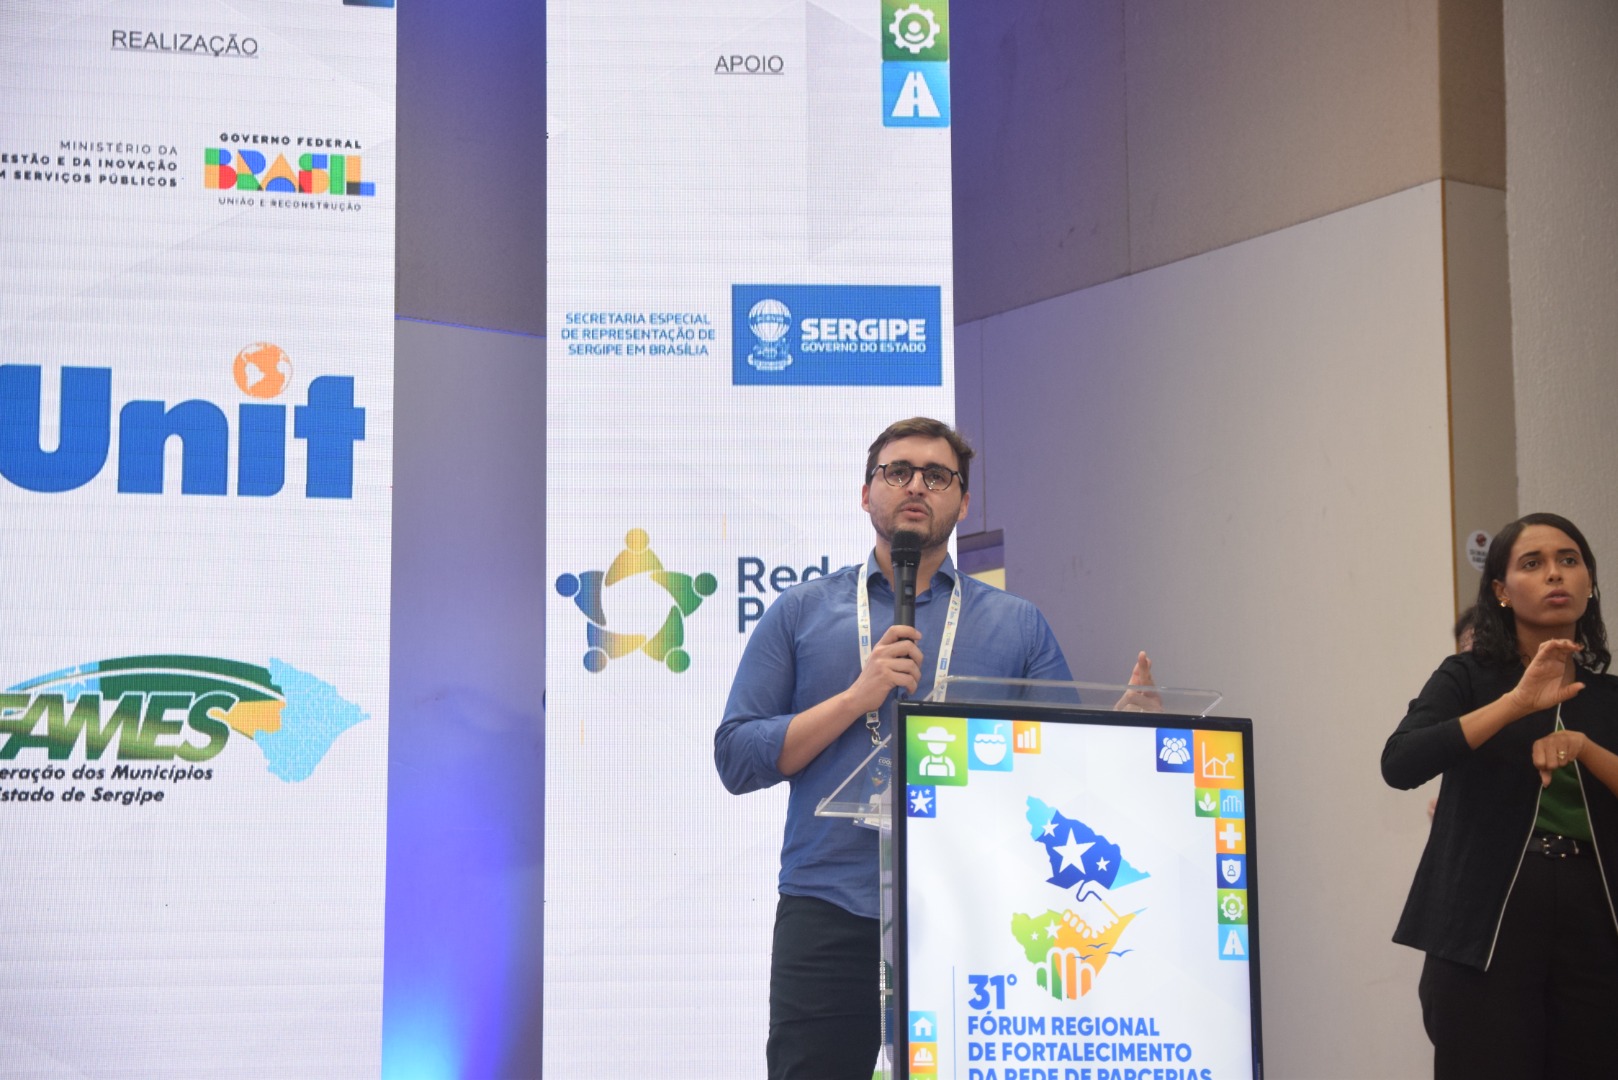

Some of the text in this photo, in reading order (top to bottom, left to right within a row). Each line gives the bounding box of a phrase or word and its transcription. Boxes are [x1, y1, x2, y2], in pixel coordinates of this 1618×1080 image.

[111, 30, 259, 57] REALIZAÇÃO
[715, 55, 784, 73] APOIO
[60, 140, 178, 155] MINISTÉRIO DA
[220, 133, 362, 149] GOVERNO FEDERAL
[57, 156, 65, 166] E
[73, 157, 91, 167] DA
[98, 158, 178, 172] INOVAÇÃO
[204, 148, 376, 196] BRASIL
[14, 170, 91, 183] SERVIÇOS
[99, 173, 177, 187] PÚBLICOS
[218, 196, 362, 212] UNIÃO E RECONSTRUÇÃO
[565, 313, 710, 325] SECRETARIA ESPECIAL
[561, 327, 715, 342] DE REPRESENTAÇÃO DE
[801, 318, 926, 341] SERGIPE
[568, 342, 709, 356] SERGIPE EM BRASÍLIA
[801, 342, 927, 353] GOVERNO DO ESTADO
[0, 342, 365, 499] Unit
[72, 765, 105, 780] dos
[110, 764, 214, 783] Municípios
[0, 785, 165, 805] stado de Sergipe
[968, 1011, 1160, 1037] FÓRUM REGIONAL
[968, 1042, 1193, 1063] DE FORTALECIMENTO
